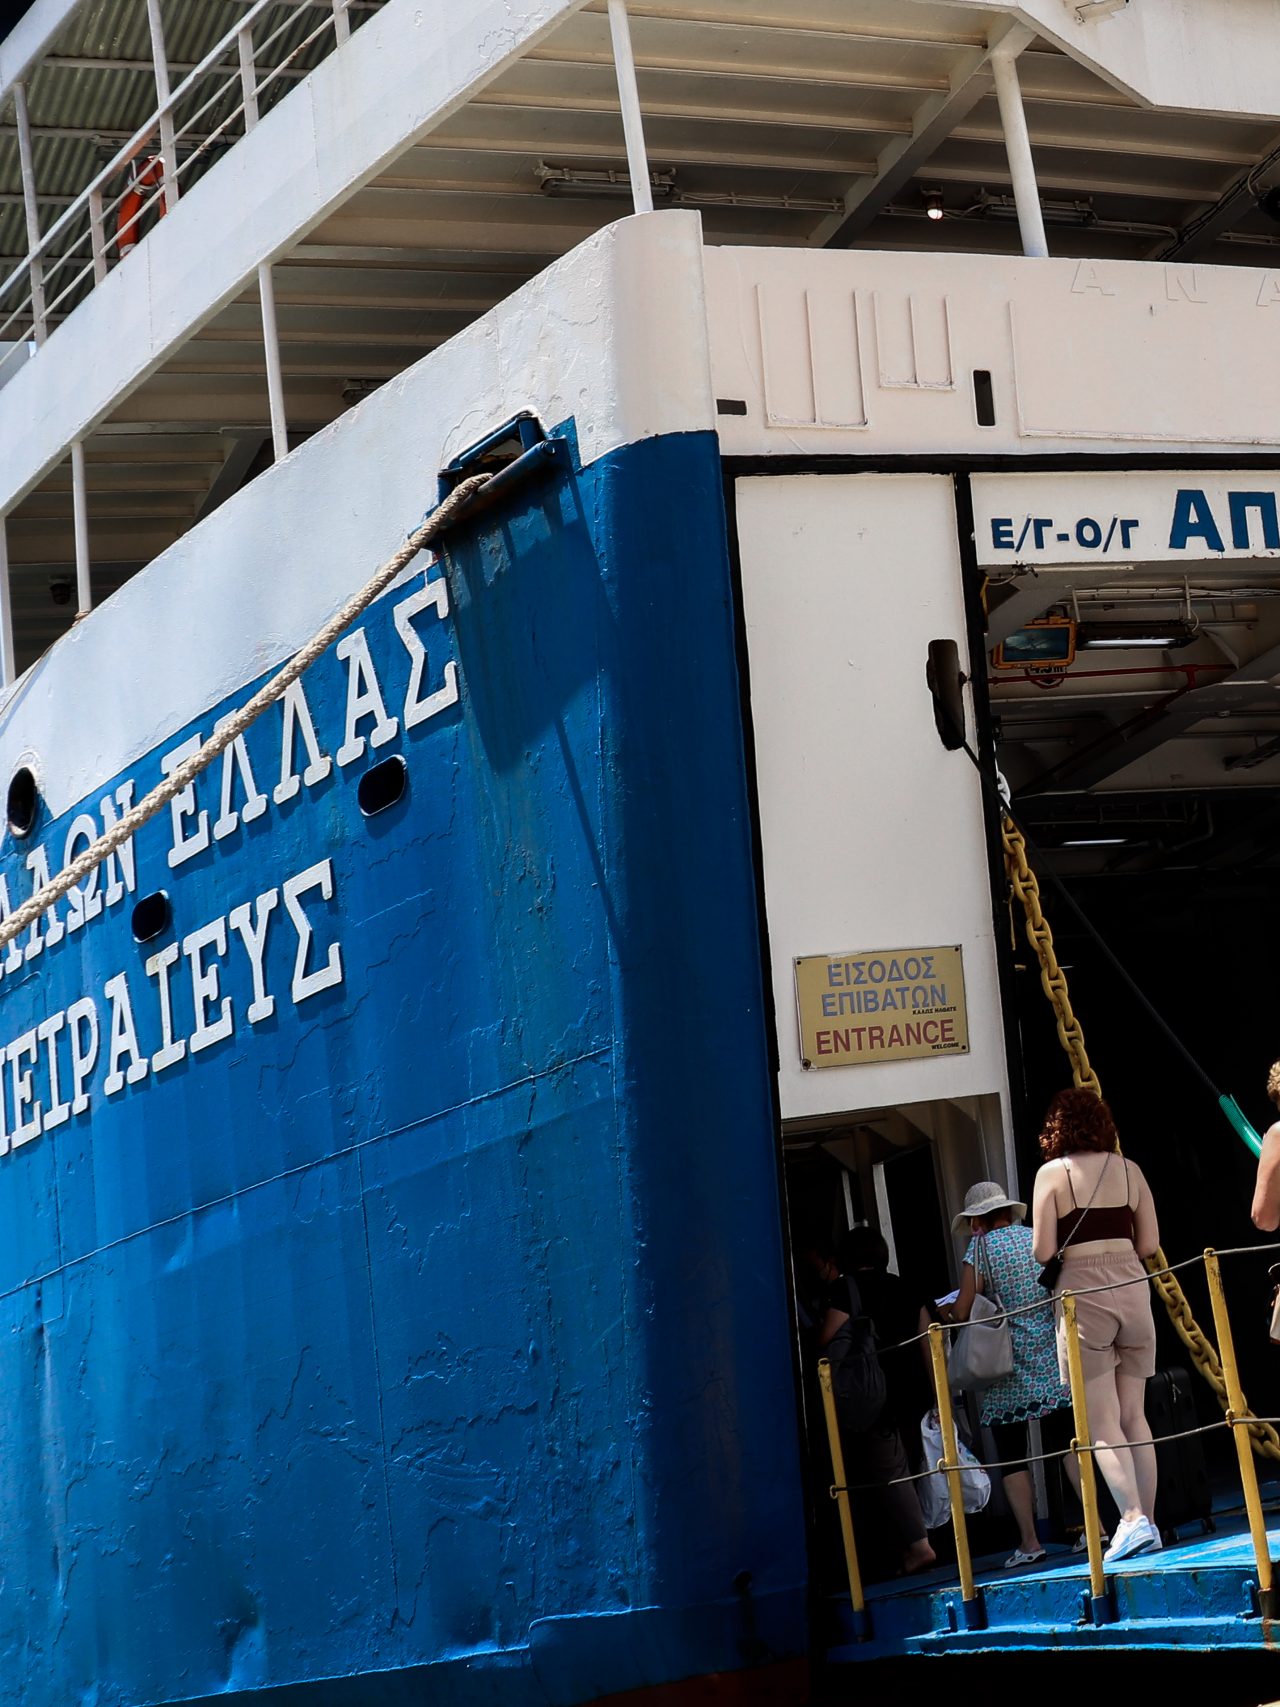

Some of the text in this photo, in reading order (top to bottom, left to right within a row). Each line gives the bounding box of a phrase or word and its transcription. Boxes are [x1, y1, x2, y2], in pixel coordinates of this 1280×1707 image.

[991, 514, 1139, 552] Ε/Γ-Ο/Γ
[161, 577, 458, 868] ΕΛΛΑΣ
[828, 956, 936, 987] ΕΙΣΟΔΟΣ
[0, 858, 342, 1157] ΕΙΡΑΙΕΥΣ
[821, 983, 948, 1017] ΕΠΙΒΑΤΩΝ
[815, 1018, 955, 1055] ENTRANCE
[931, 1042, 960, 1050] WELCOME
